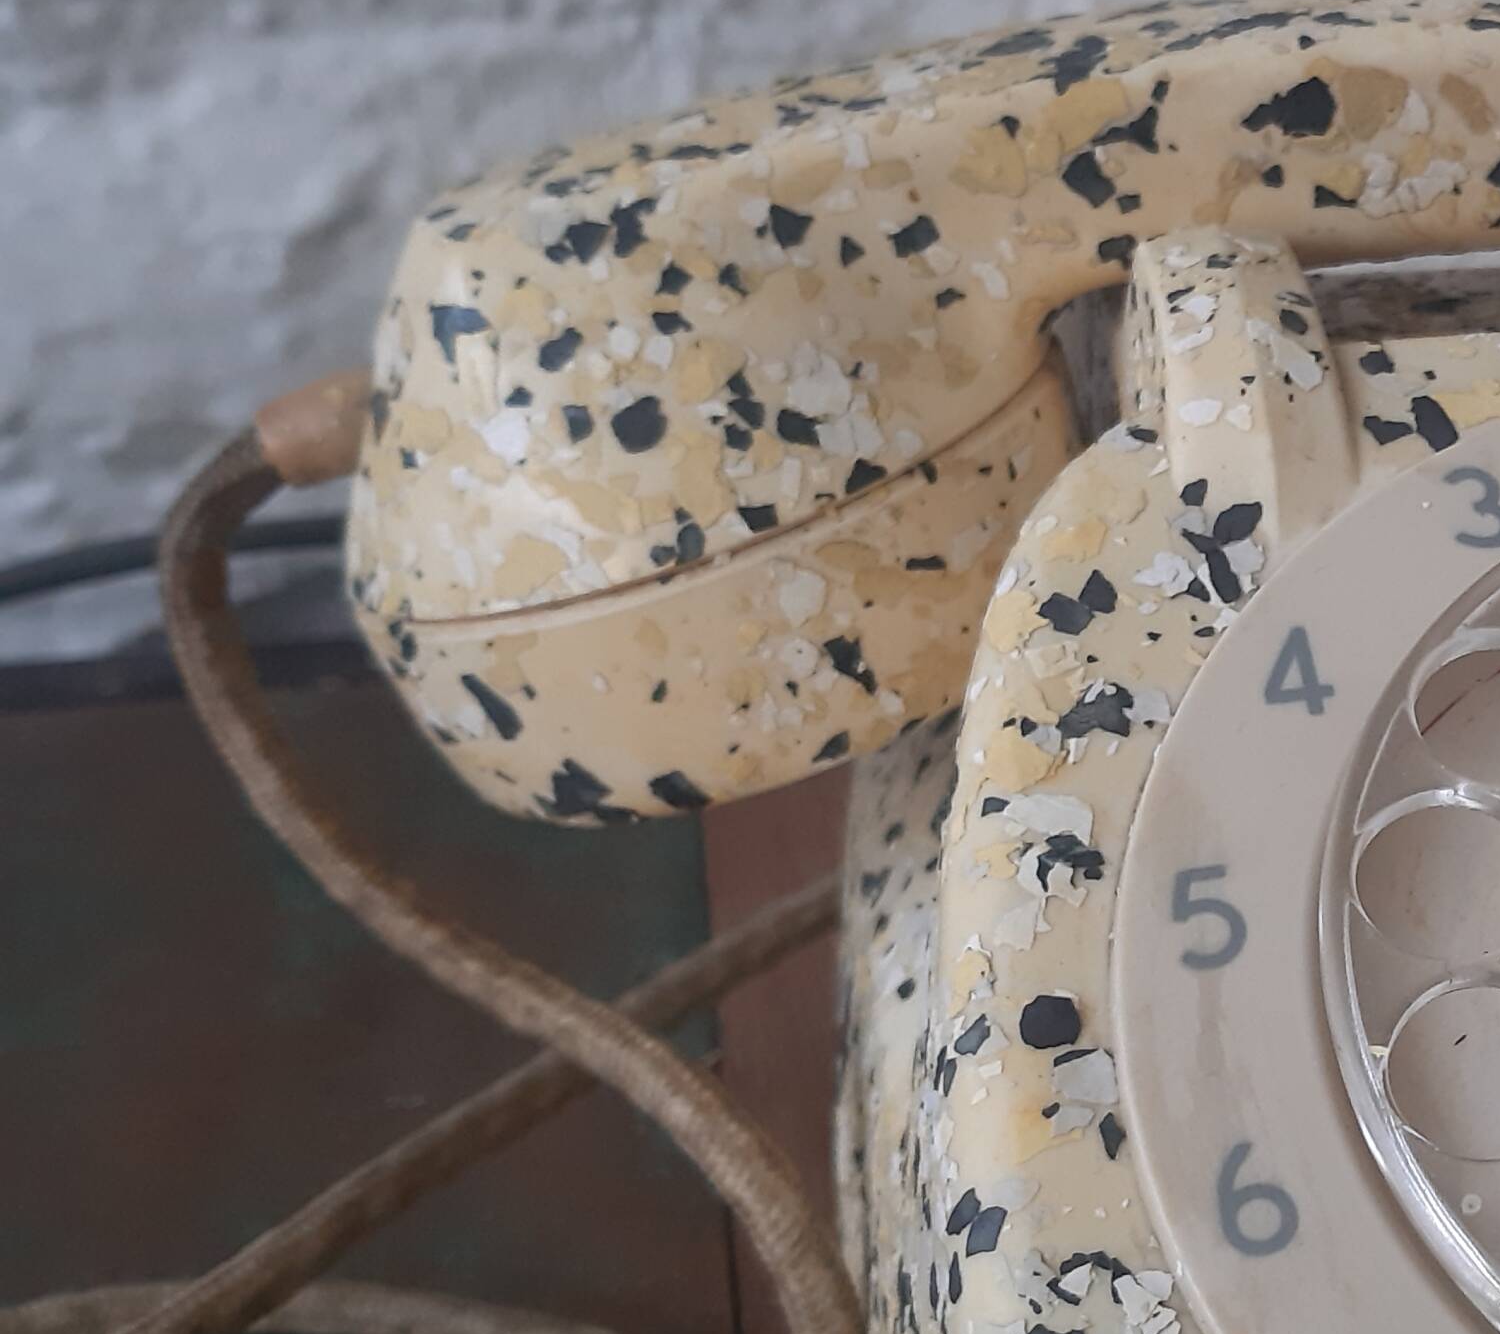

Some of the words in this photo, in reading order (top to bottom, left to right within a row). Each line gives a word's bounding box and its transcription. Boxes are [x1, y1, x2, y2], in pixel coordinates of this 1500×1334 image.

[1265, 627, 1335, 715] 4
[1171, 865, 1247, 970] 5
[1216, 1141, 1298, 1256] 6
